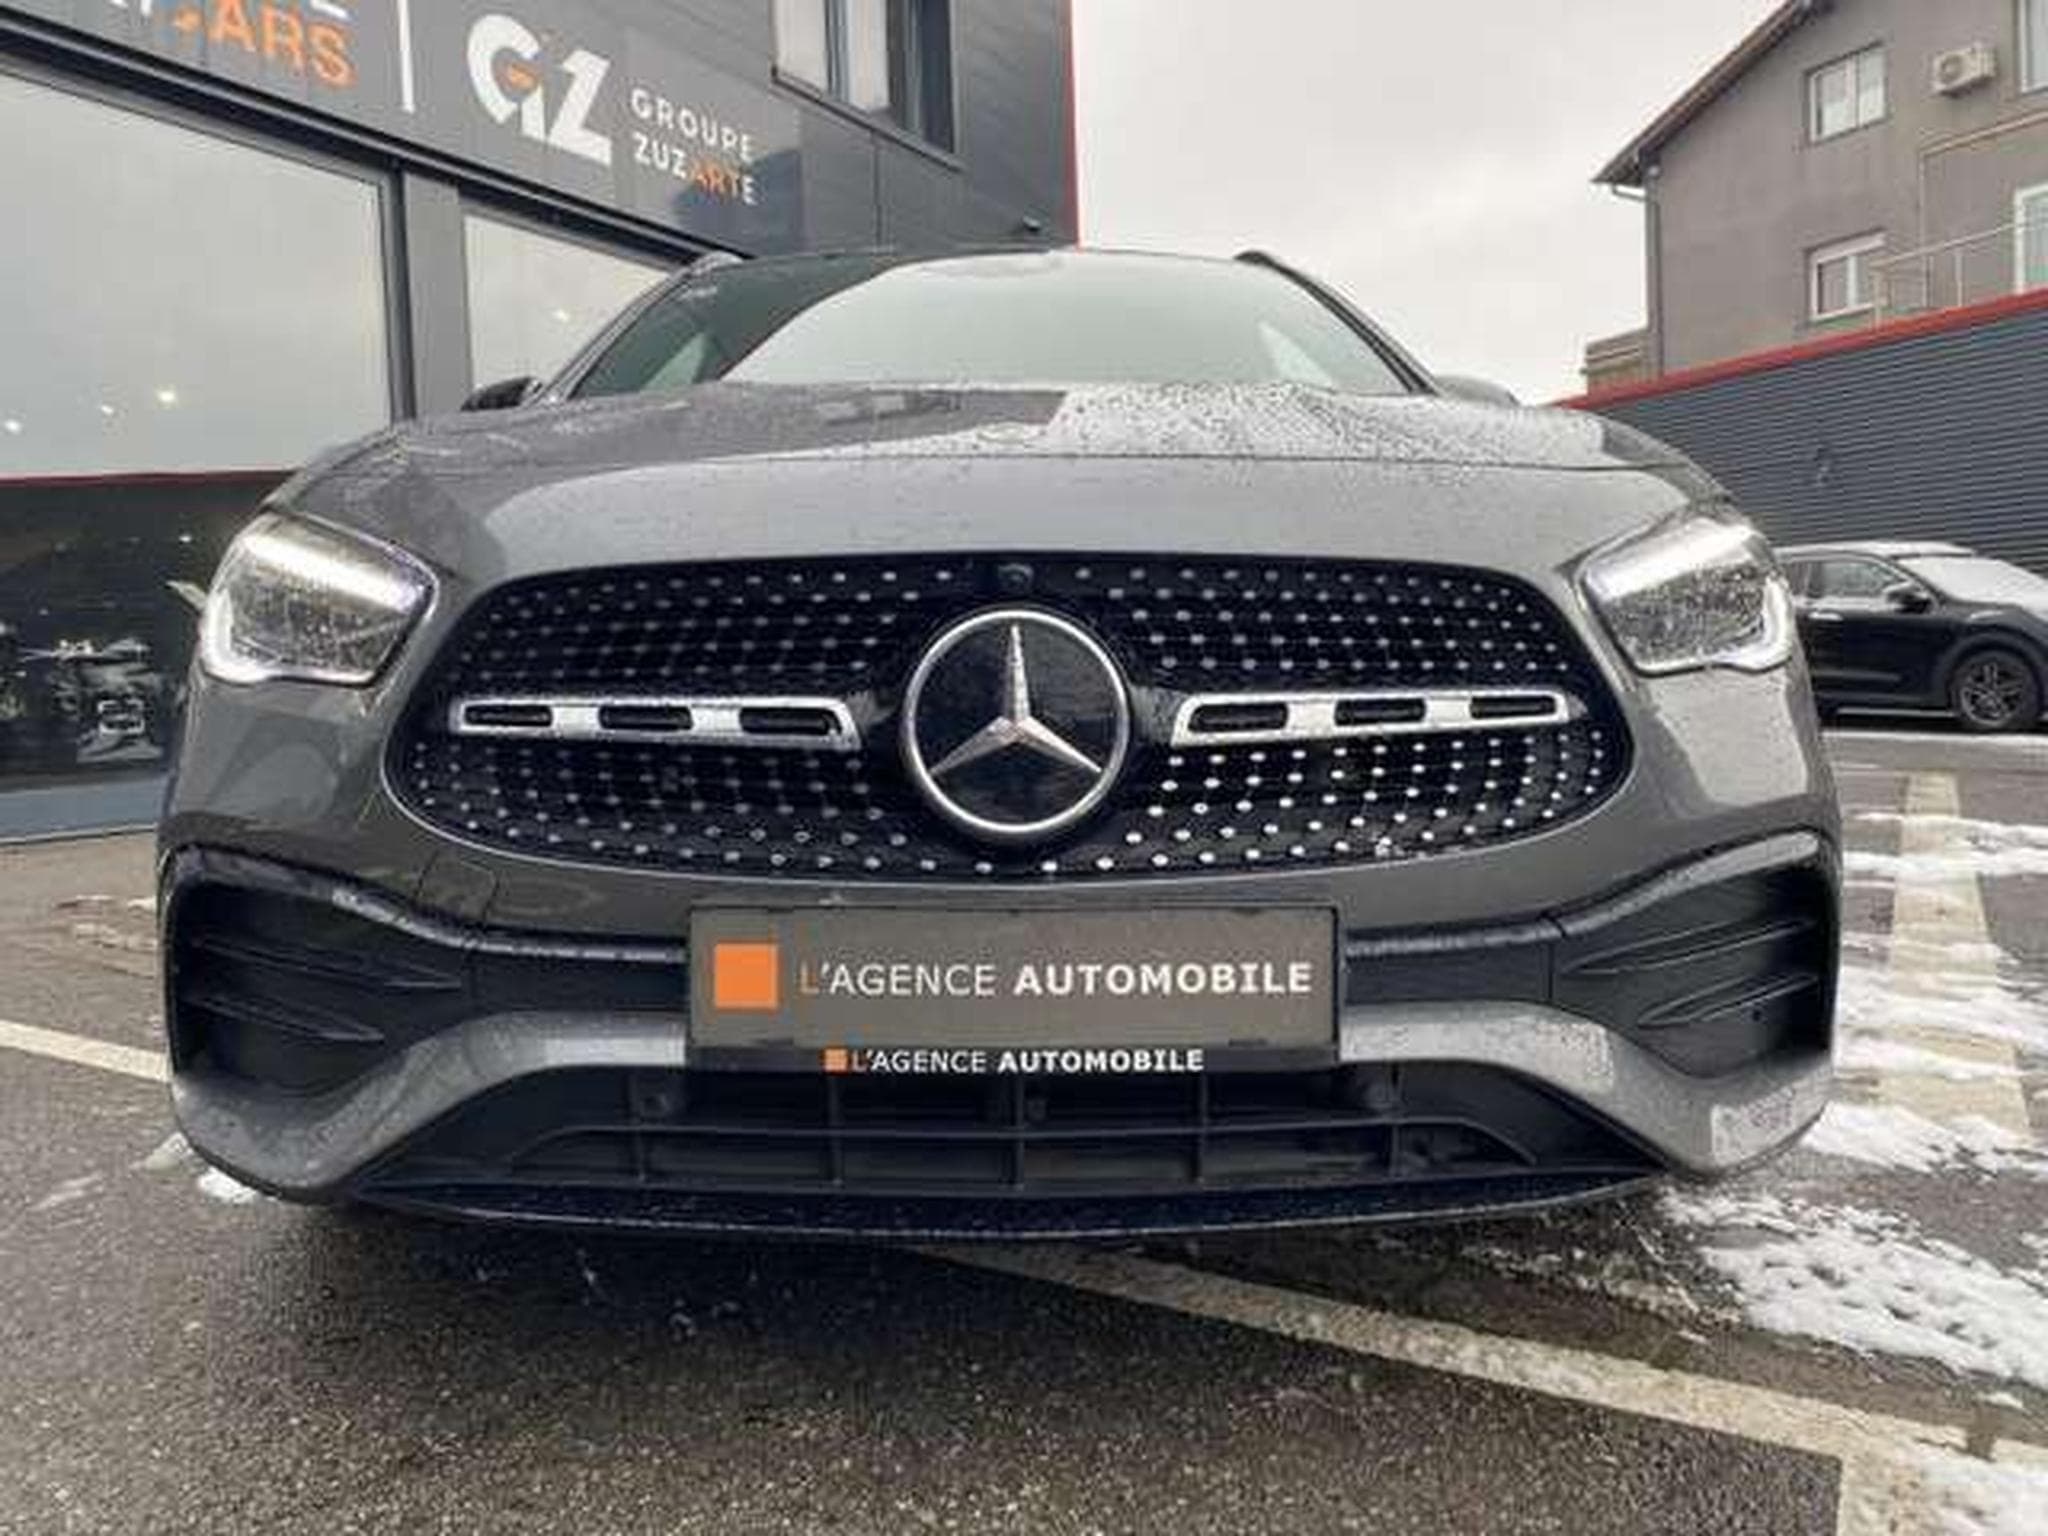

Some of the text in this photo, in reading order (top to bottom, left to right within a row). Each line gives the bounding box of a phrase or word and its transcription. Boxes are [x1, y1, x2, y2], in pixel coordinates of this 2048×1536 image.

[630, 87, 753, 160] GROUPE
[631, 132, 757, 206] ZUZARTE
[800, 961, 1313, 997] L'AGENCE AUTOMOBILE
[851, 1048, 1205, 1074] L'AGENCE AUTOMOBILE
